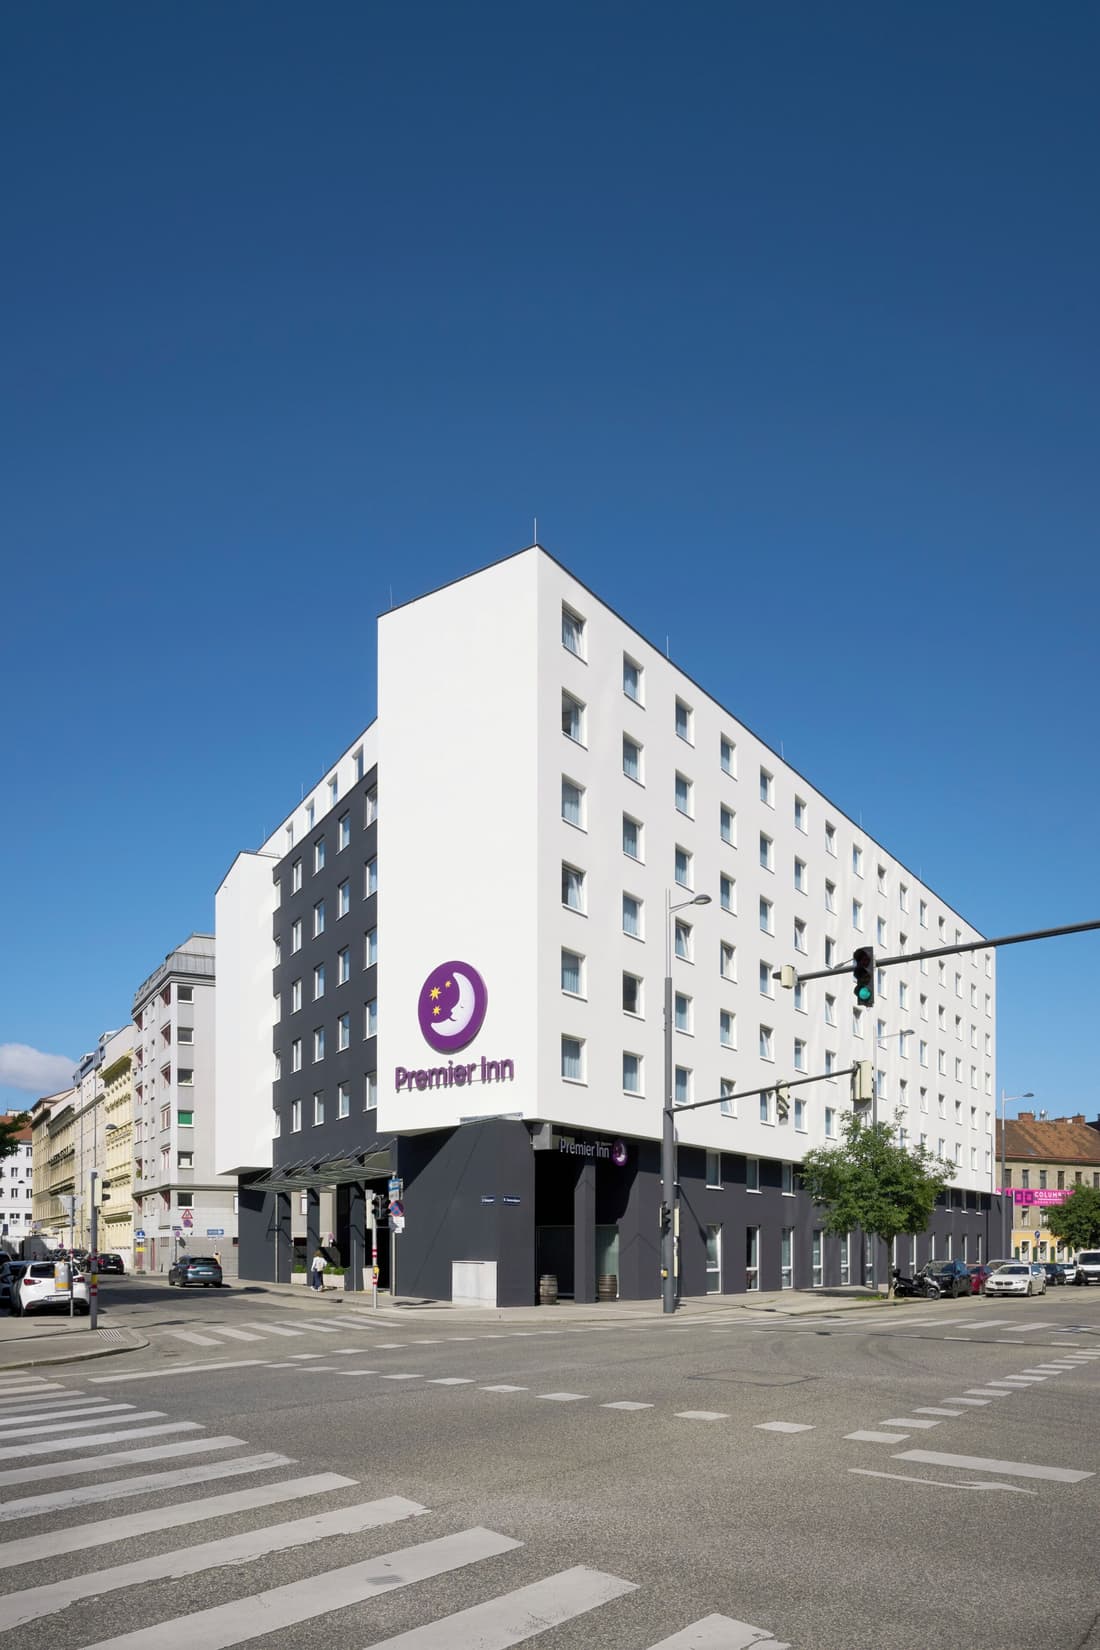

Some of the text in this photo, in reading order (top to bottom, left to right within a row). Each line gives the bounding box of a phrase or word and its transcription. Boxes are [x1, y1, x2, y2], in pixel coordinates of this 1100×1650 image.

[395, 1056, 514, 1092] Premier Inn
[560, 1138, 610, 1159] Premier Inn
